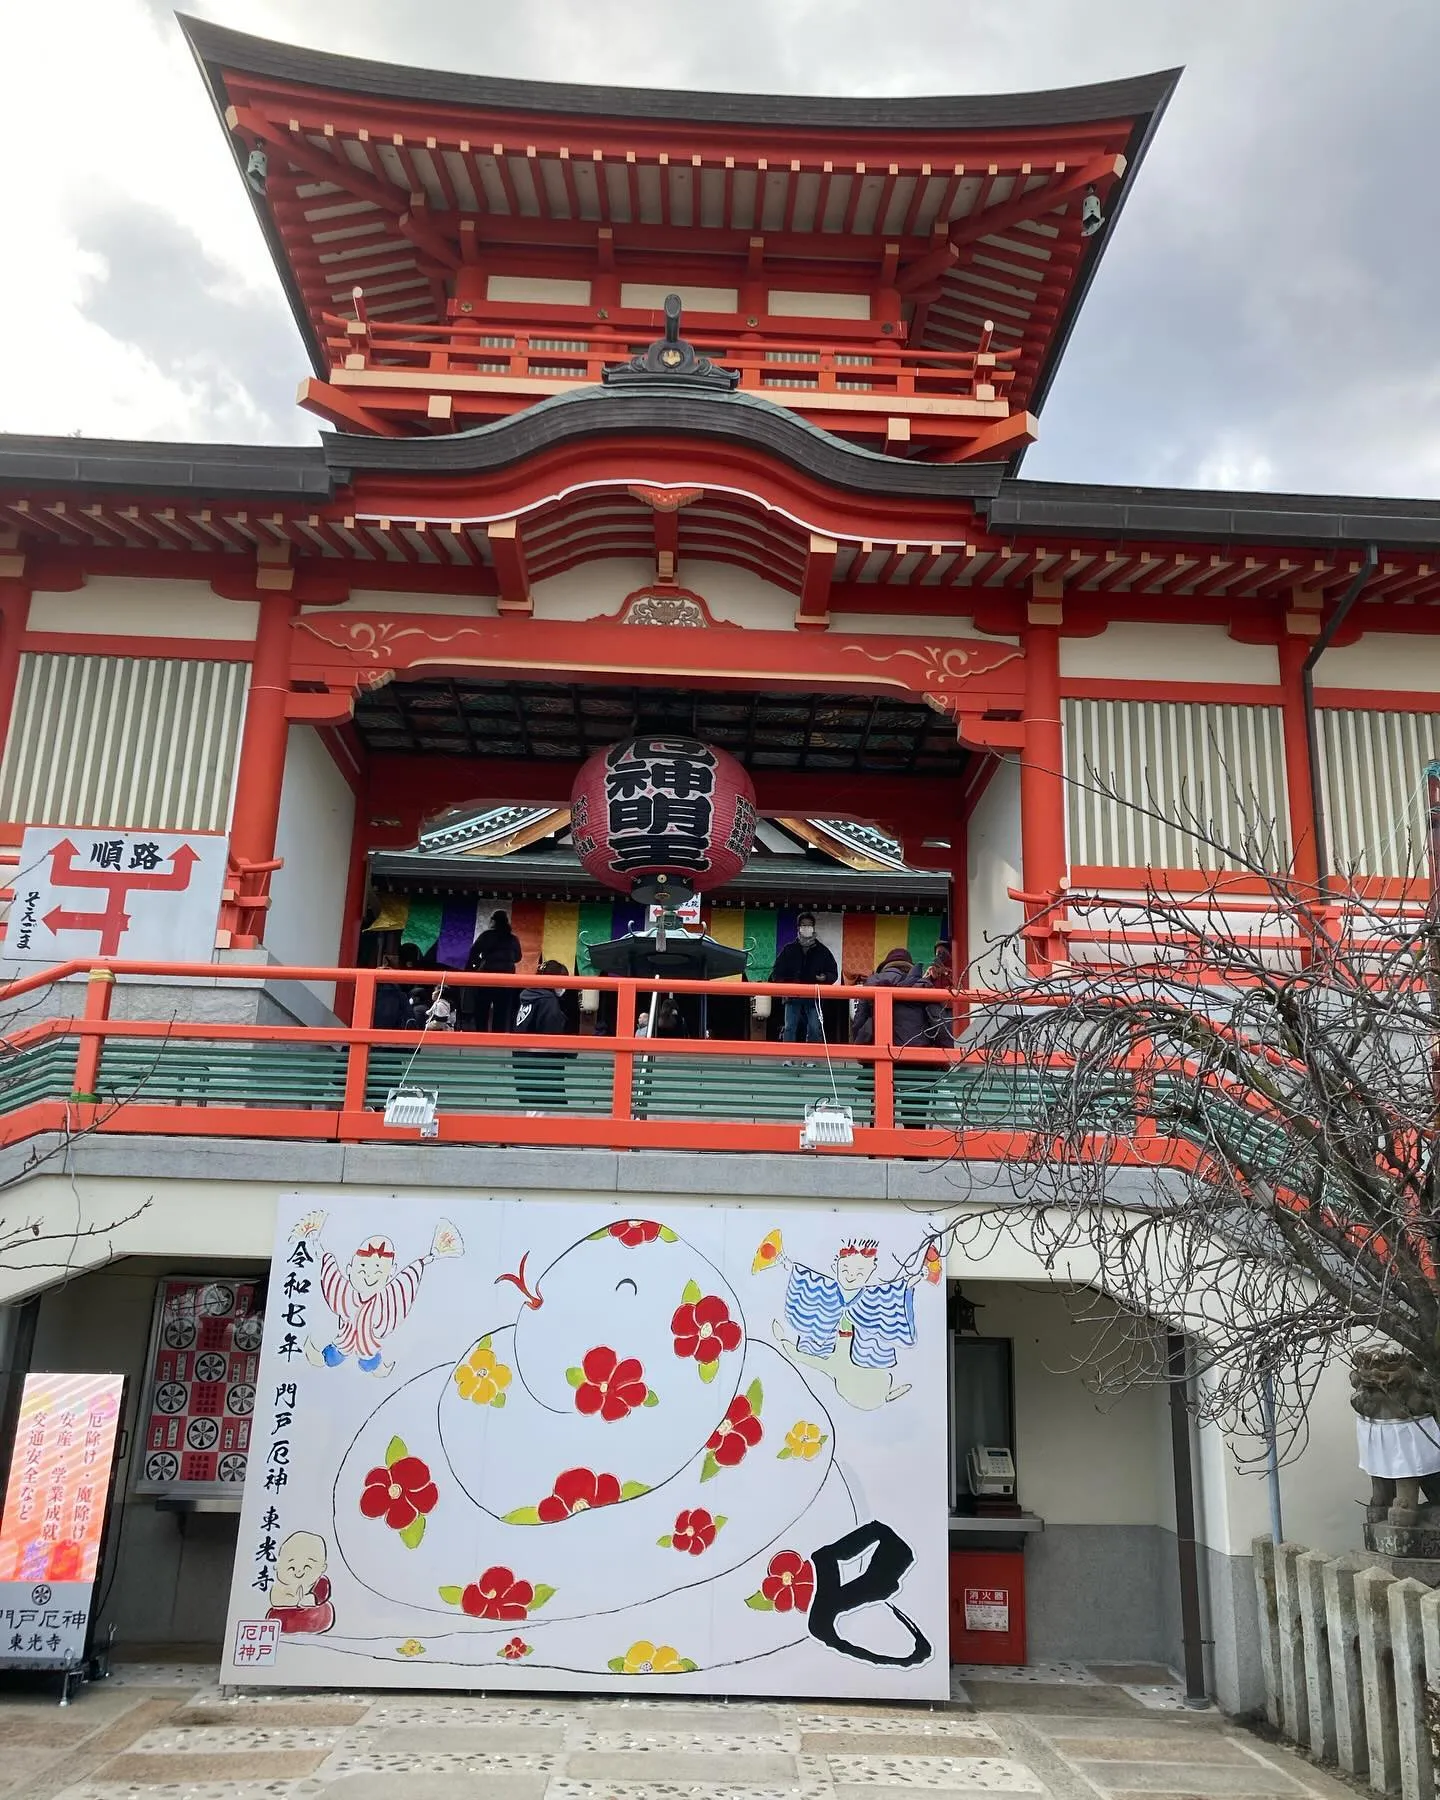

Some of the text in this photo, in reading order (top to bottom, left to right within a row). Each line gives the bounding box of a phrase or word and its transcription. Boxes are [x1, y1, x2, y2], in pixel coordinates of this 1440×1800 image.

[89, 840, 163, 871] 順路
[16, 891, 41, 950] そえごま
[251, 1240, 314, 1592] 令和七年 門戸厄神 東光寺
[20, 1411, 47, 1521] 交通安全など
[41, 1411, 76, 1541] 安産・学業成就
[72, 1412, 104, 1540] 厄除け・魔除け
[0, 1610, 87, 1630] 門戸厄神
[969, 1591, 1004, 1601] 消火器
[8, 1633, 62, 1652] 東光寺
